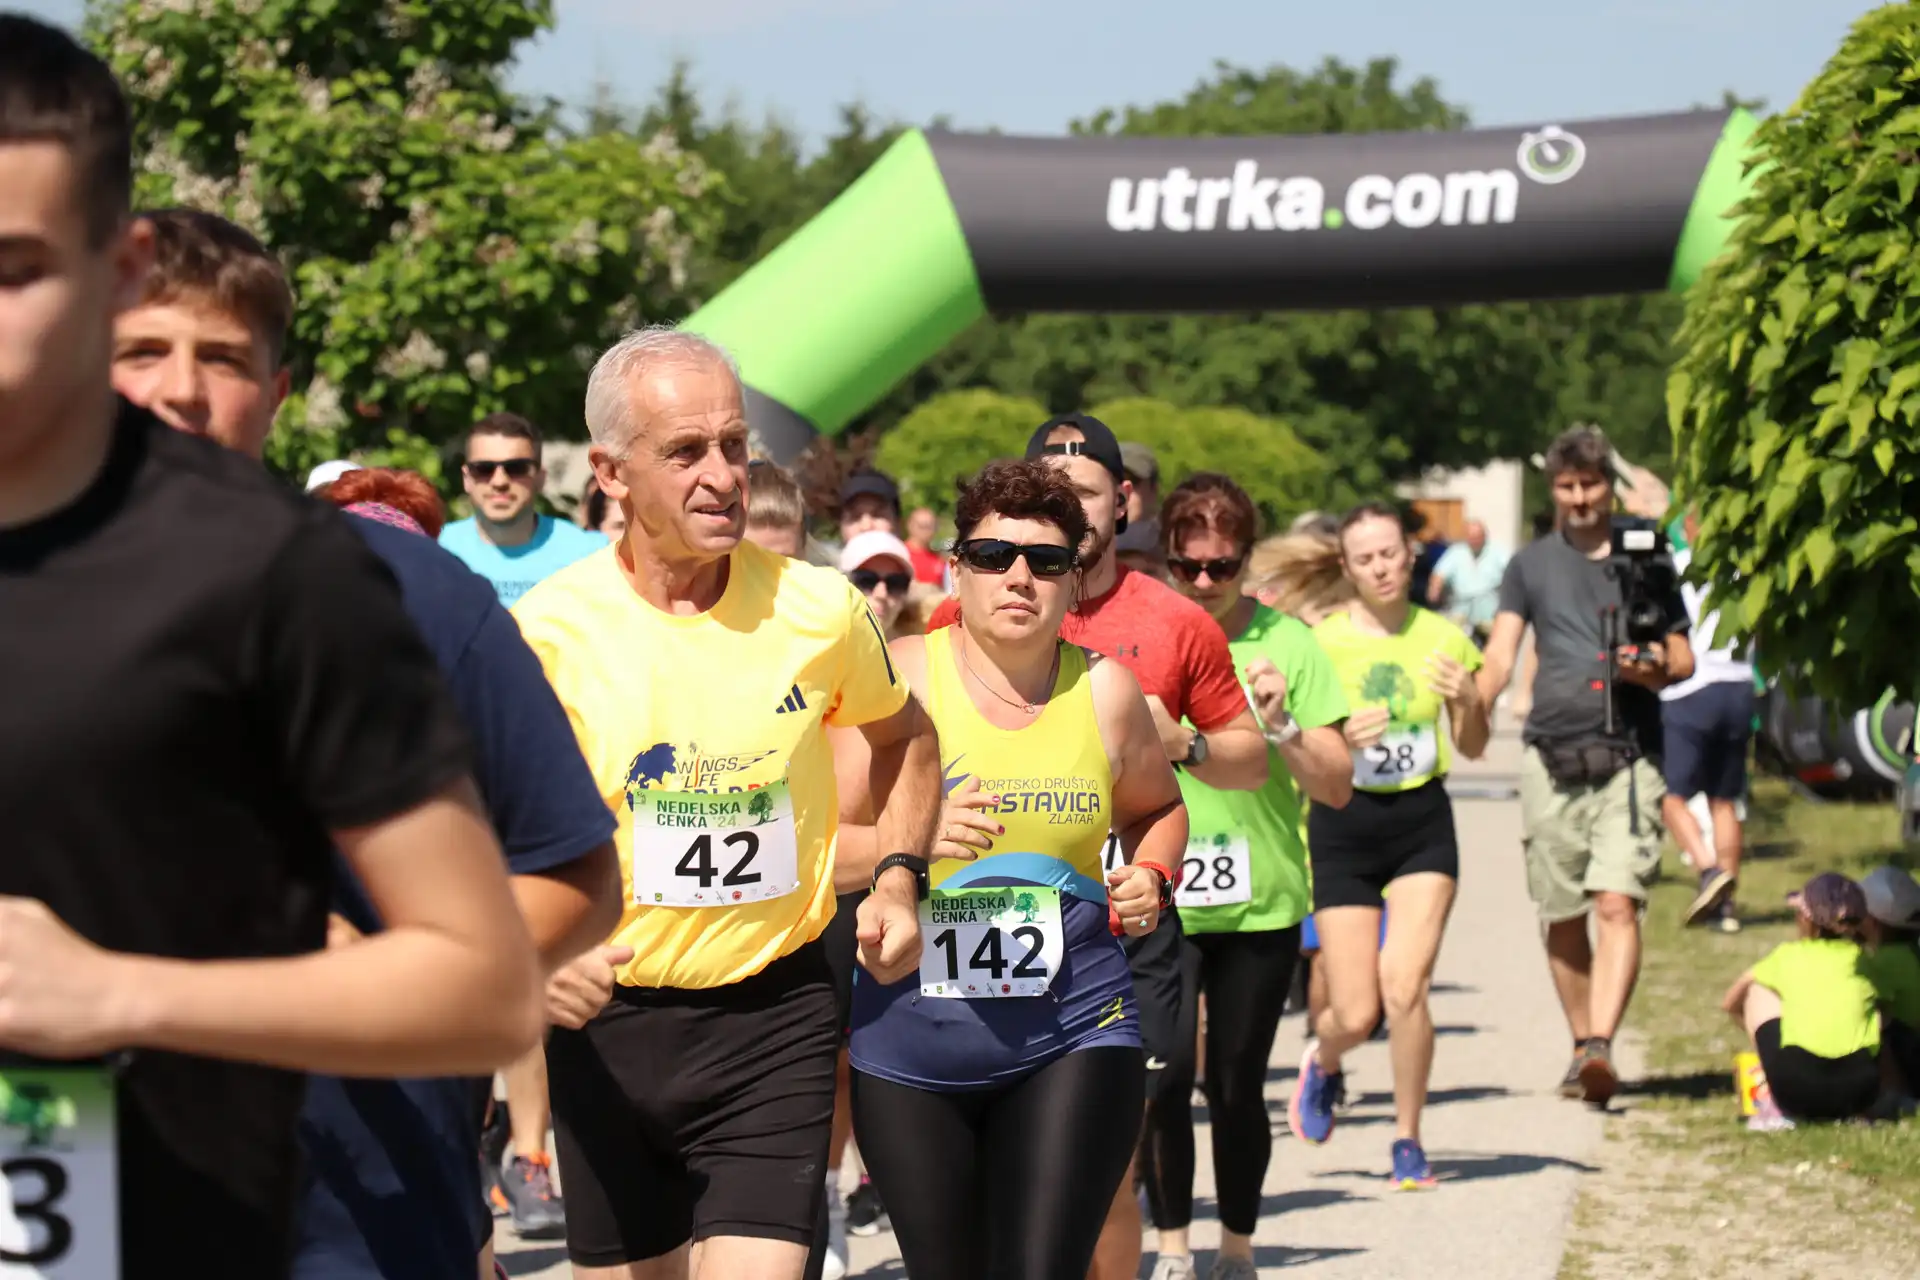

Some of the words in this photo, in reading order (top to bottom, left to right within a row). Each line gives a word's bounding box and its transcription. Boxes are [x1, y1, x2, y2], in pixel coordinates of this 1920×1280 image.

[1106, 159, 1520, 232] utrka.com
[979, 777, 1041, 791] PORTSKO
[1045, 776, 1099, 790] DRUŠTVO
[656, 799, 742, 816] NEDELSKA
[977, 791, 1101, 814] STAVICA
[656, 813, 708, 828] CENKA
[1049, 813, 1095, 825] ZLATAR
[674, 830, 762, 888] 42
[931, 896, 1007, 911] NEDELSKA
[932, 910, 978, 924] CENKA
[933, 925, 1048, 981] 142
